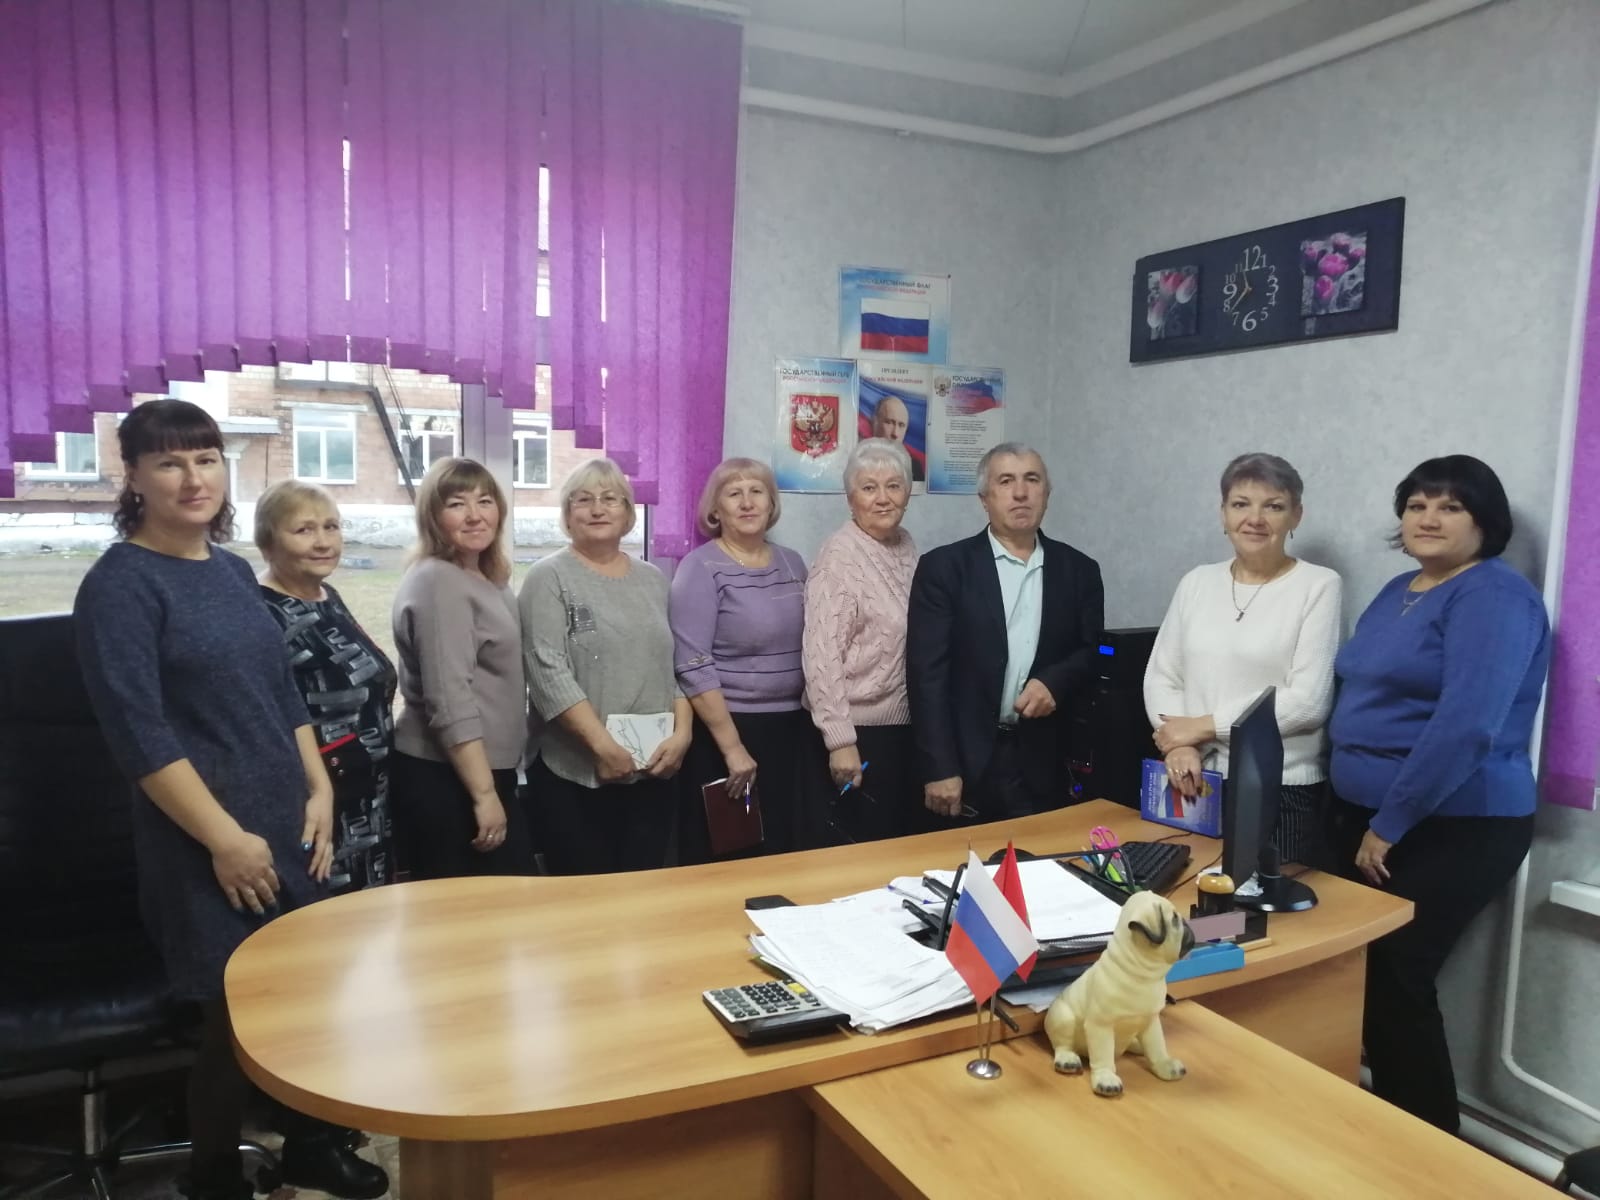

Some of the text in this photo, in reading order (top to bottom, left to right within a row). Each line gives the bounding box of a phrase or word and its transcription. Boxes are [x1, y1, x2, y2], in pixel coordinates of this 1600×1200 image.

[1243, 245, 1261, 272] 12
[1225, 273, 1236, 284] 10
[1267, 275, 1279, 294] 3
[1223, 283, 1238, 300] 9
[1223, 299, 1230, 312] 8
[1260, 306, 1268, 321] 5
[1232, 311, 1240, 326] 7
[1242, 310, 1257, 332] 6
